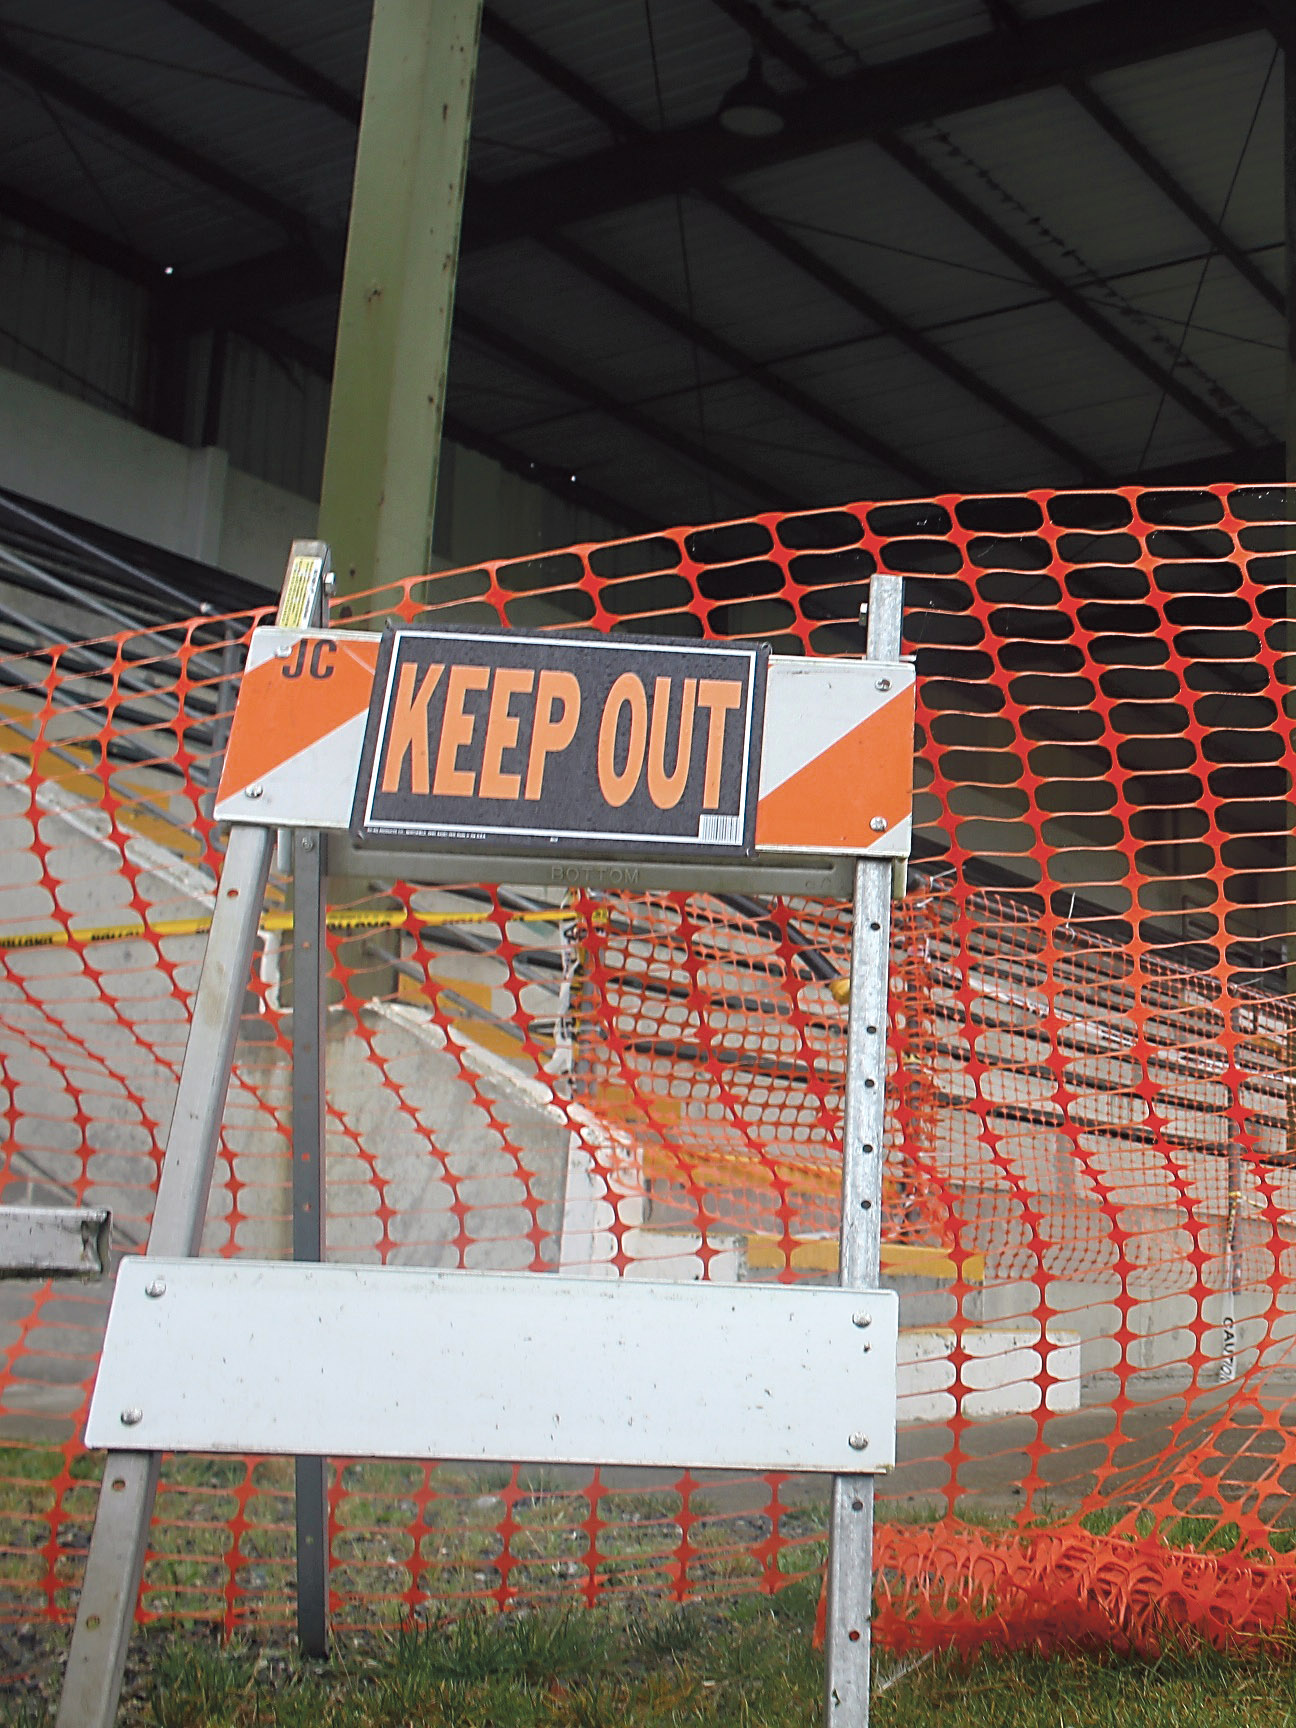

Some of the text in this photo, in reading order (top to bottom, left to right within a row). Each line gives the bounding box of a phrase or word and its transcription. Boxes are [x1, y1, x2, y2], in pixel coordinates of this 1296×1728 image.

[282, 638, 337, 679] JC
[381, 662, 743, 810] KEEP OUT
[551, 864, 640, 885] BOTTOM
